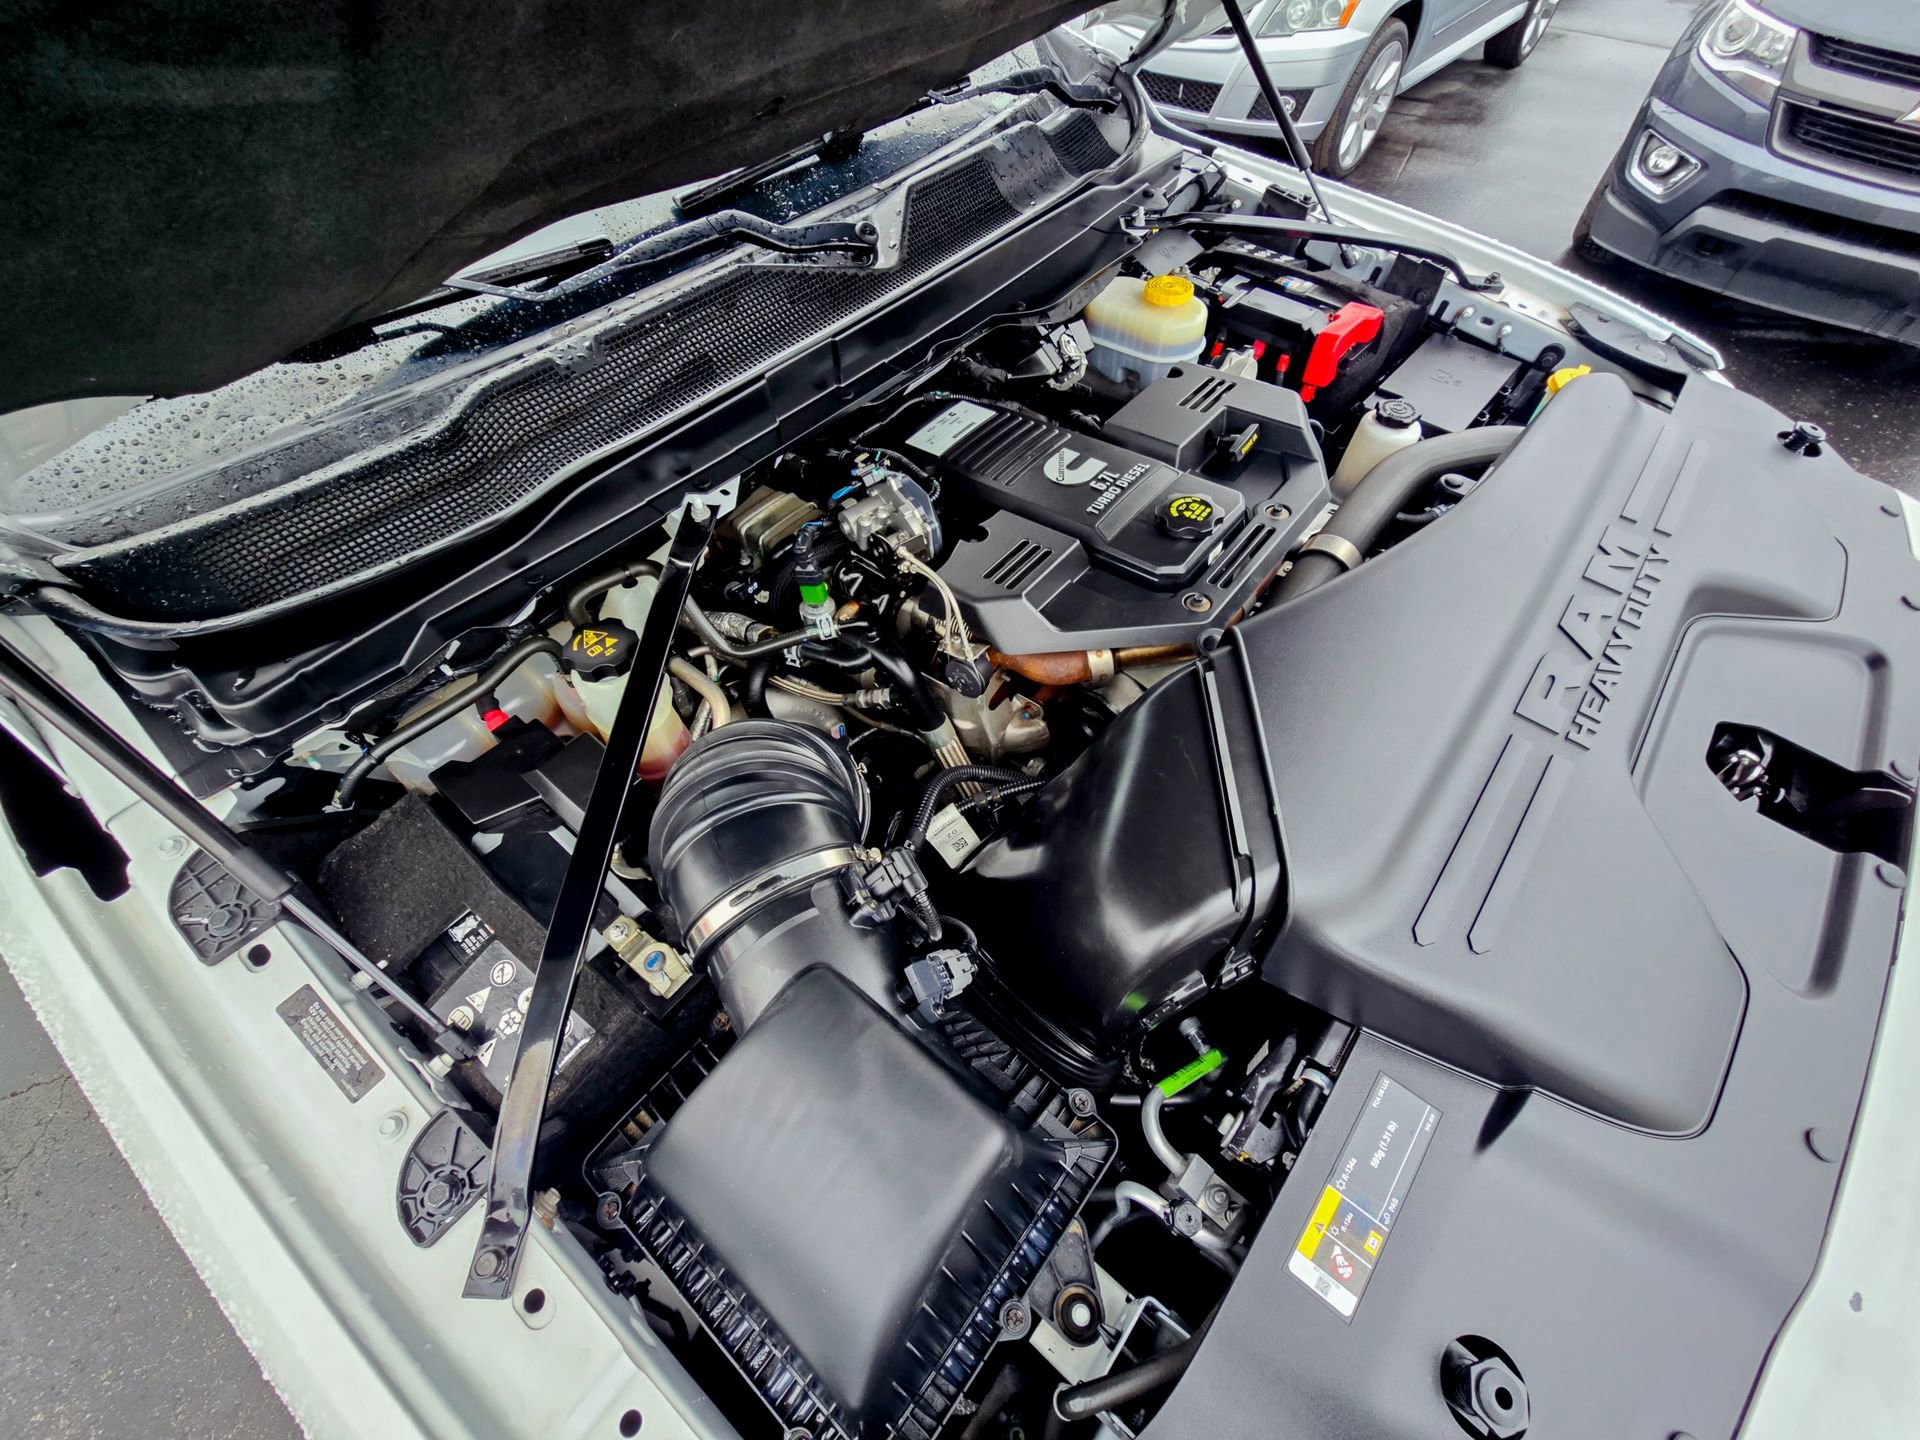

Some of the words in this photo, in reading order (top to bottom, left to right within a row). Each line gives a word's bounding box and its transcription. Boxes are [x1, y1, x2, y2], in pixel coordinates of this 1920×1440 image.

[1056, 450, 1065, 482] Cummins
[1089, 470, 1120, 491] 6.7L
[1086, 485, 1122, 515] TURBO
[1119, 462, 1151, 488] DIESEL
[1513, 524, 1640, 736] RAM
[1564, 625, 1634, 751] HEAVY
[1617, 543, 1670, 630] DUTY
[1370, 1148, 1386, 1169] 595g
[1379, 1128, 1394, 1152] (1.31
[1389, 1120, 1400, 1134] lb)
[1341, 1157, 1358, 1182] R-134a
[1388, 1197, 1400, 1214] PAG
[1340, 1212, 1354, 1233] R-134a
